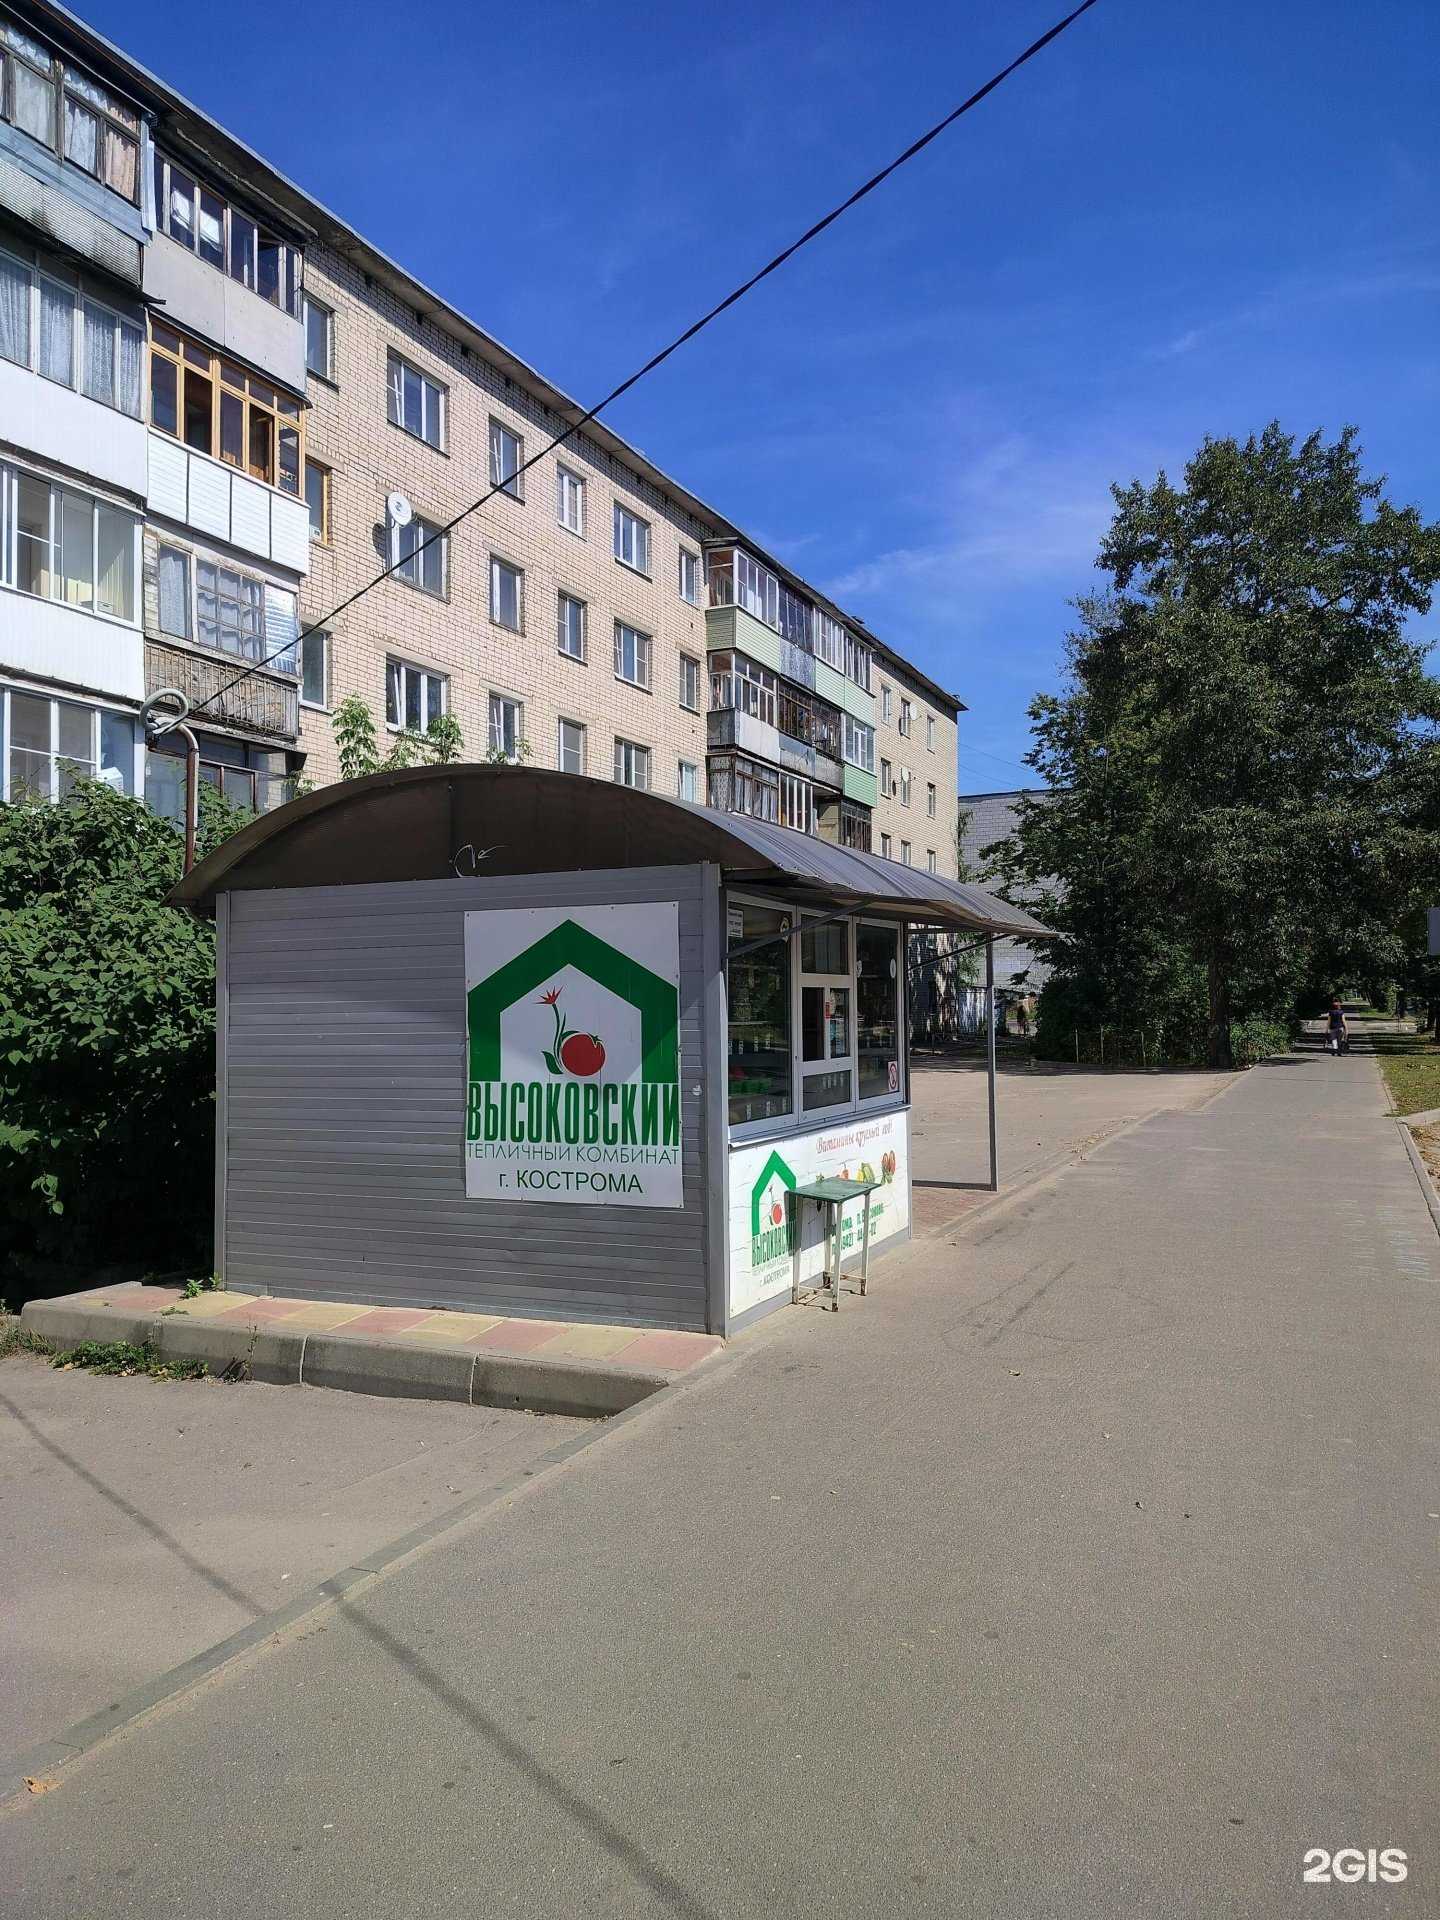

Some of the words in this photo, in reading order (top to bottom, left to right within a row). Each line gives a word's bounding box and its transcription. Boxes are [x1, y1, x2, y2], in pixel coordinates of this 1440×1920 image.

[576, 1145, 679, 1165] КОМБИНАТ
[498, 1173, 508, 1188] г.
[517, 1169, 644, 1194] КОСТРОМА
